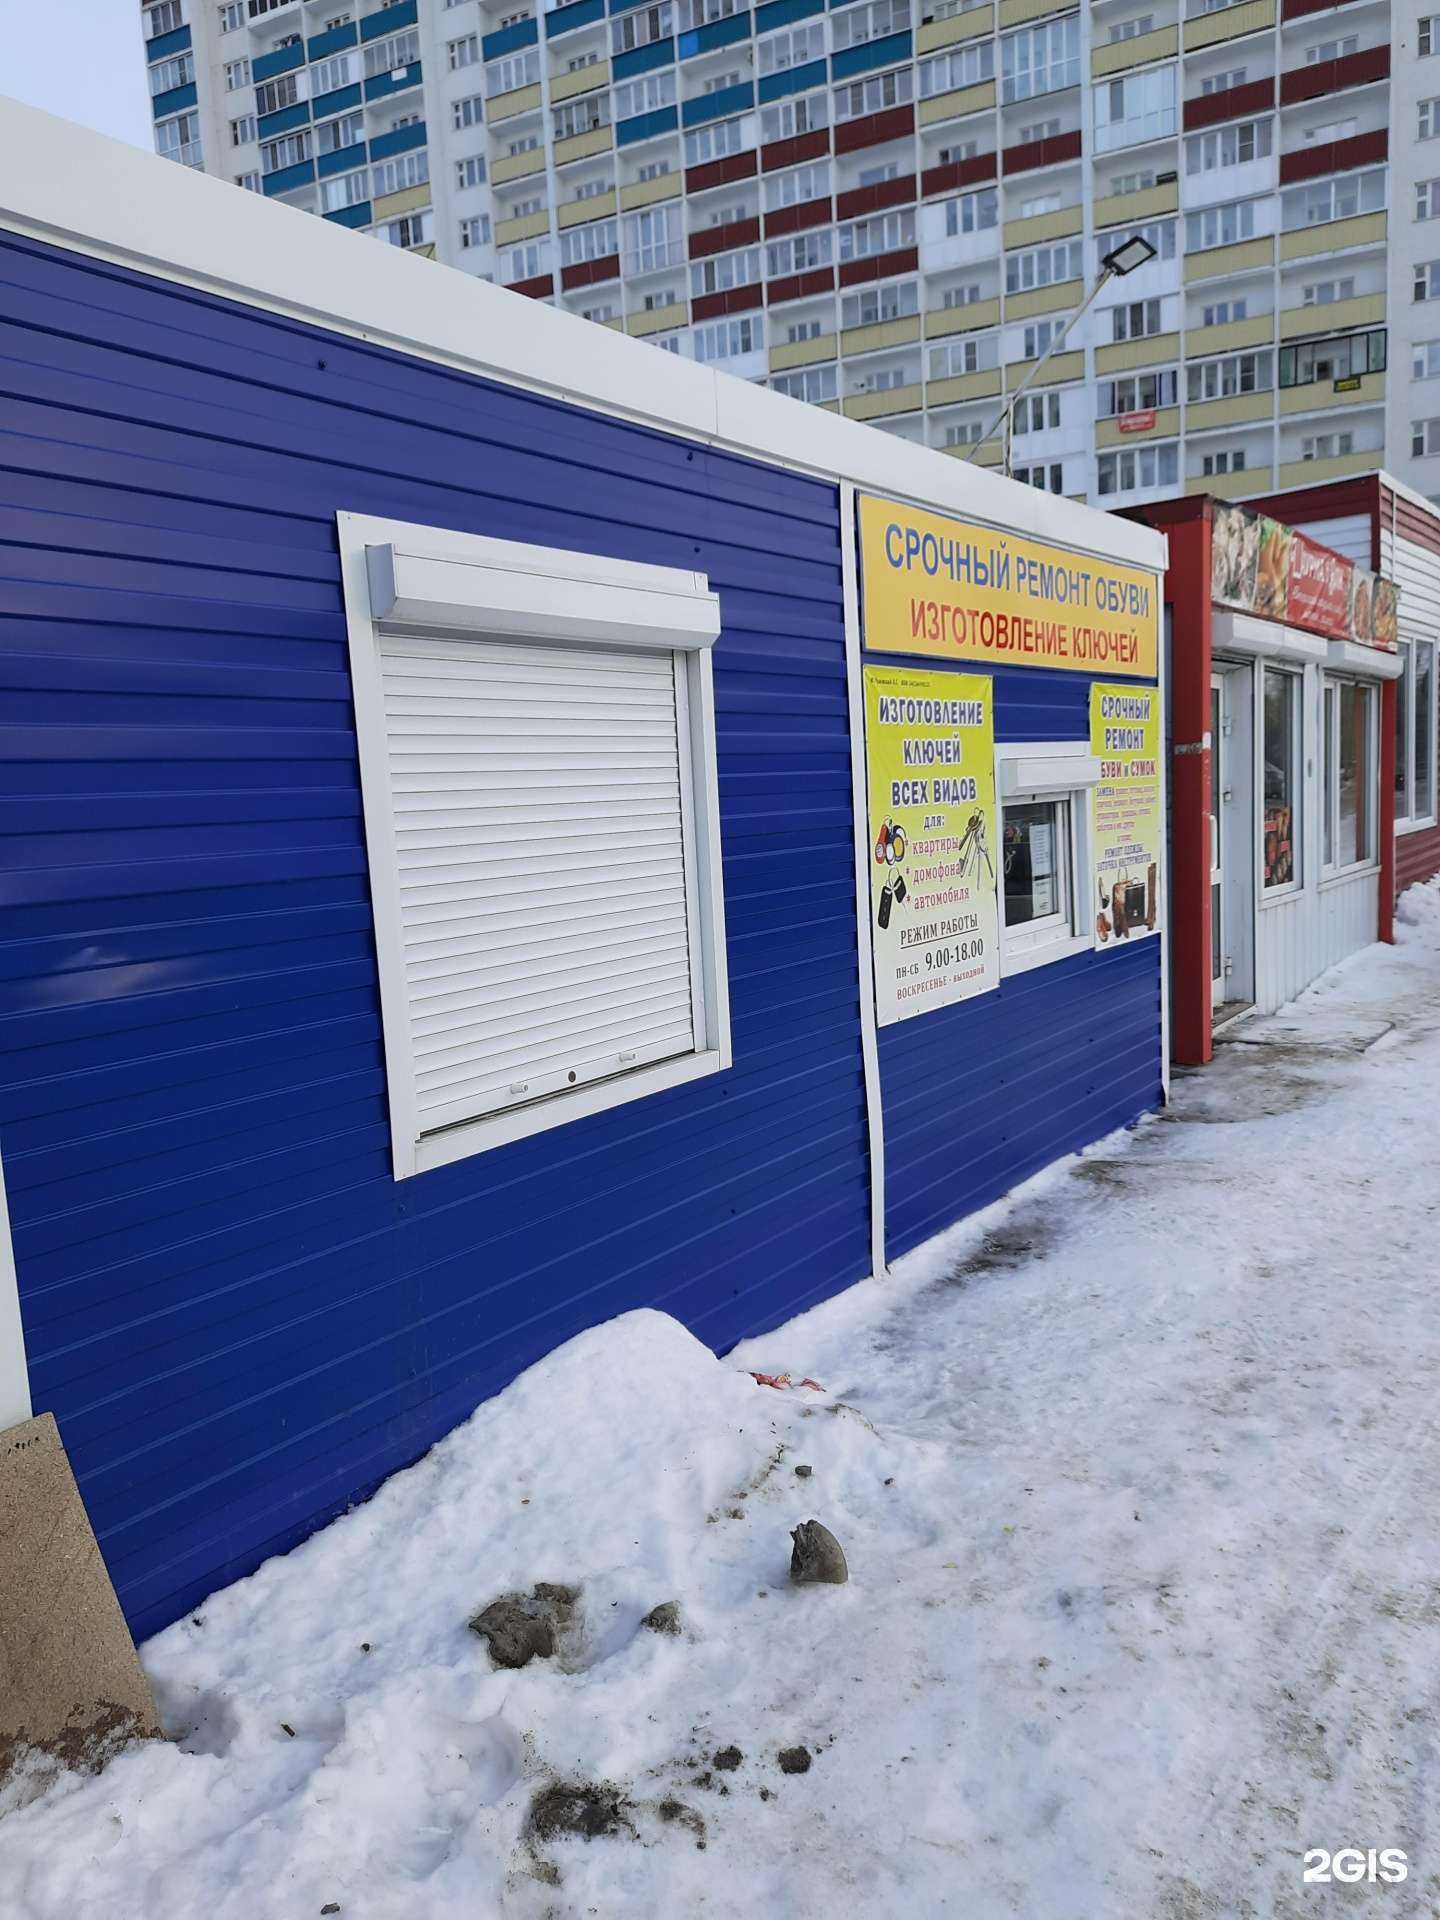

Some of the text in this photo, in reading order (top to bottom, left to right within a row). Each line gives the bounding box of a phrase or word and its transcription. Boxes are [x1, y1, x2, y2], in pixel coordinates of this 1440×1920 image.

[885, 523, 1150, 618] СРОЧНЫЙ РЕМОНТ ОБУВИ
[911, 598, 1139, 664] ИЗГОТОВЛЕНИЕ КЛЮЧЕЙ
[879, 697, 983, 725] ИЗГОТОВЛЕНИЕ
[1101, 693, 1151, 720] СРОЧНЫЙ
[903, 733, 961, 765] КЛЮЧЕЙ
[1105, 727, 1144, 750] РЕМОНТ
[1101, 761, 1122, 778] БУВИ
[1130, 760, 1156, 777] СУМОК
[892, 778, 976, 806] ВСЕХ ВИДОВ
[911, 836, 960, 856] квартиры
[912, 862, 961, 886] домофона
[914, 887, 970, 911] автомобиля
[900, 913, 978, 946] РЕЖИМ РАБОТЫ
[896, 938, 984, 980] ПН-СБ 9.00-18.00
[896, 975, 947, 1001] ВОСКРЕСЕНЬЕ
